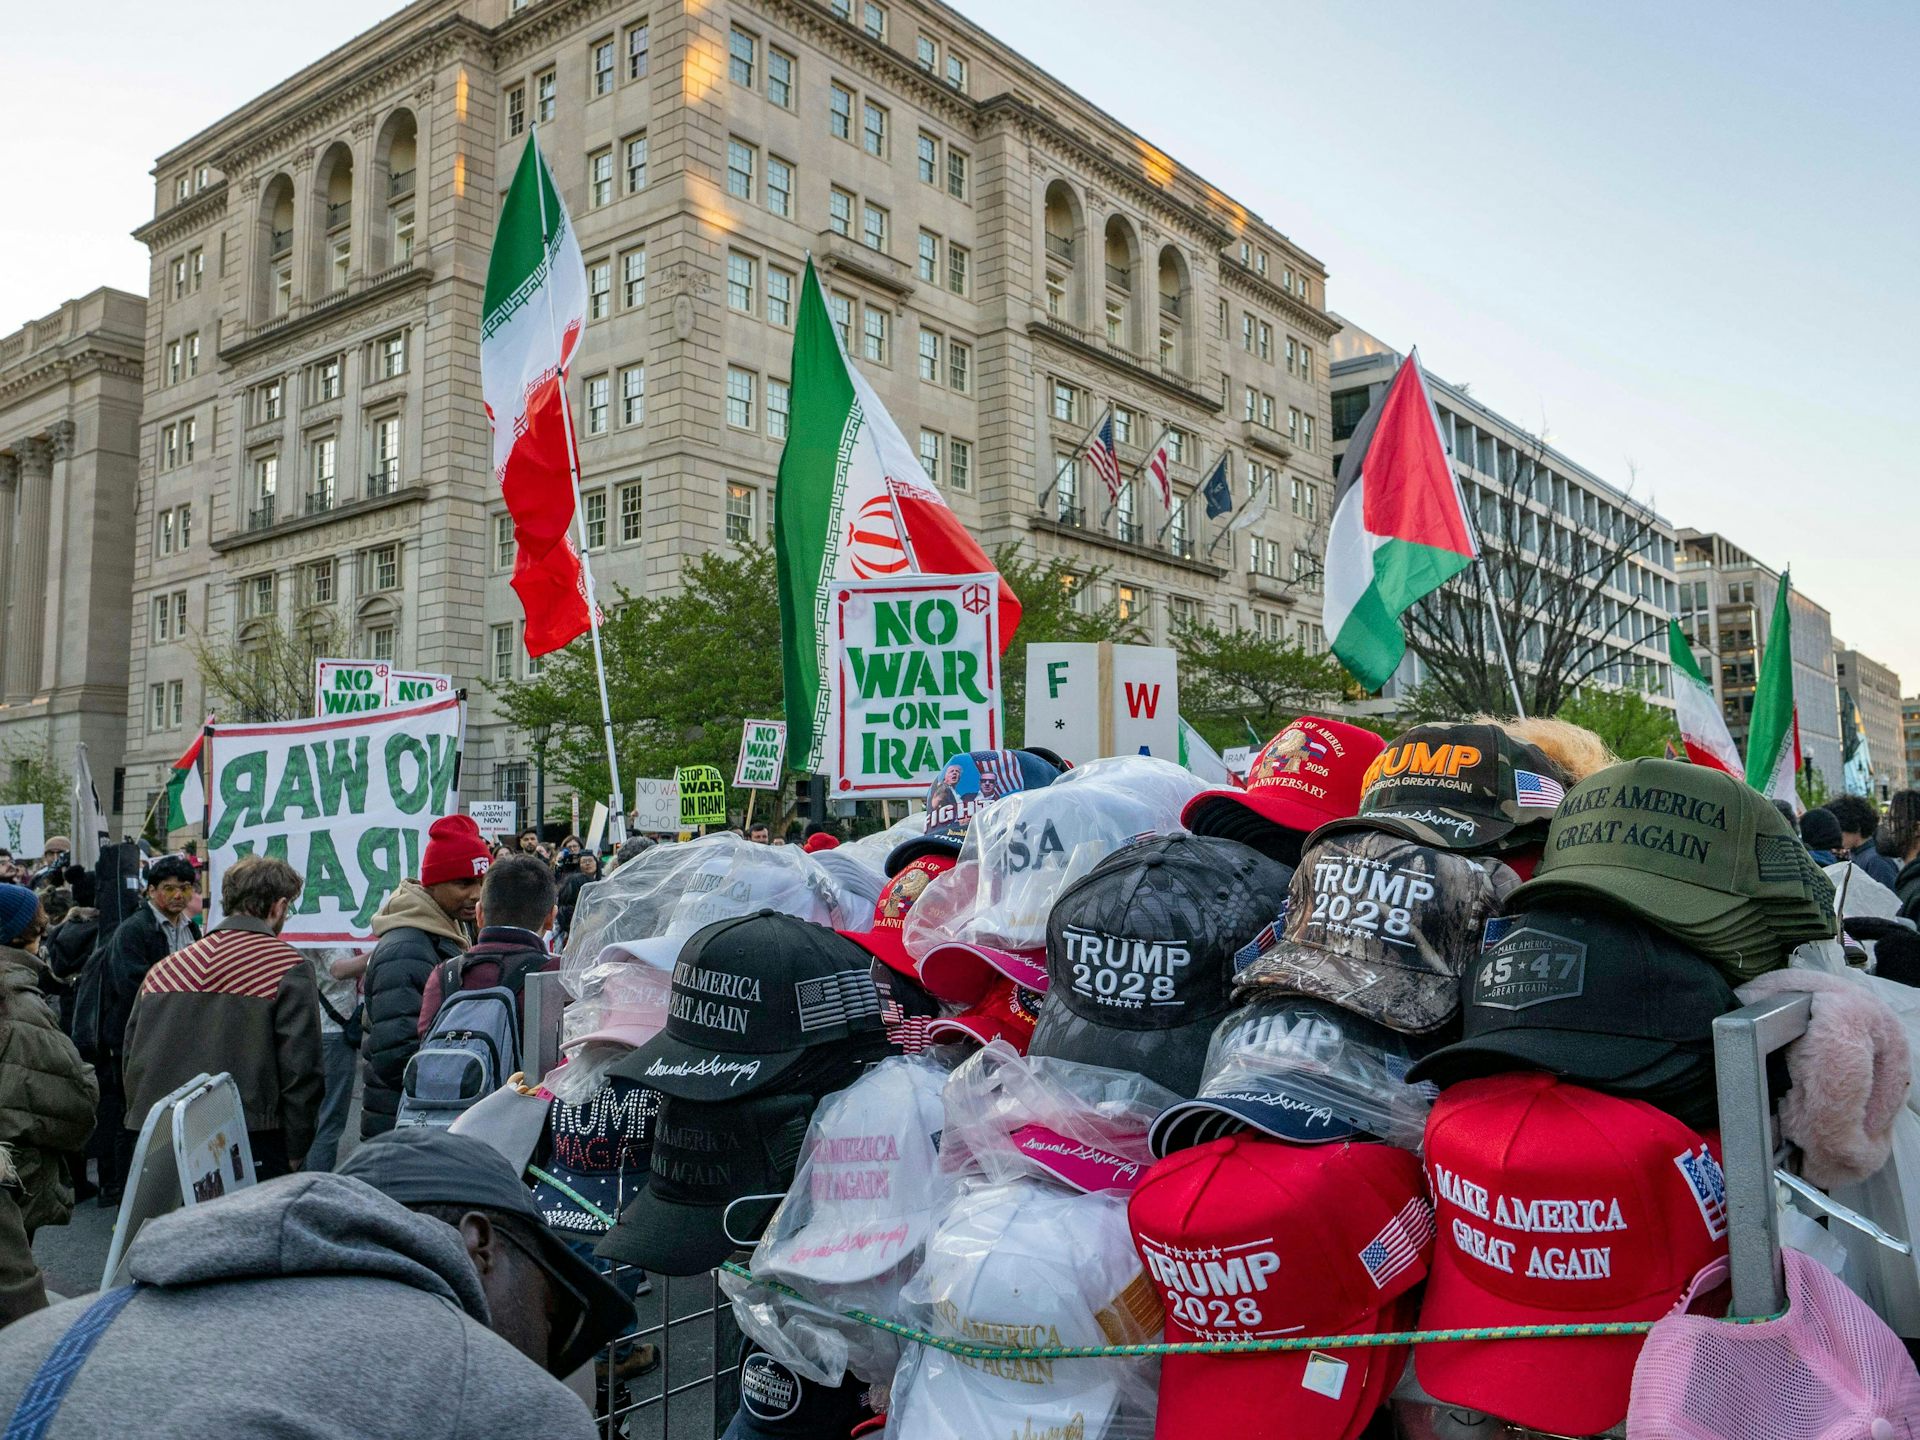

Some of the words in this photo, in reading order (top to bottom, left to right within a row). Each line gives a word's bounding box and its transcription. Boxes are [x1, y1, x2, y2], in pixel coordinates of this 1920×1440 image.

[873, 598, 959, 648] NO
[335, 668, 374, 692] NO
[397, 680, 434, 702] NO
[846, 647, 989, 705] WAR
[746, 739, 779, 761] WAR
[755, 726, 777, 742] NO
[1304, 721, 1319, 731] OF
[1316, 727, 1346, 759] AMERICA
[861, 728, 971, 780] IRAN
[1225, 752, 1247, 764] IRAN
[1304, 761, 1330, 778] 2026
[637, 781, 657, 795] NO
[660, 782, 679, 796] WA
[679, 768, 703, 781] STOP
[680, 780, 723, 794] WAR
[743, 766, 774, 782] IRAN
[1253, 776, 1328, 800] ANNIVERSARY
[1401, 776, 1438, 787] GREAT
[1437, 778, 1473, 794] AGAIN
[483, 816, 504, 824] NOW
[655, 798, 676, 812] OF
[681, 796, 696, 817] ON
[697, 794, 725, 816] IRAN!
[1557, 786, 1611, 821] MAKE
[1611, 784, 1728, 832] AMERICA
[1556, 820, 1623, 851] GREAT
[1621, 822, 1711, 865] AGAIN
[1313, 863, 1435, 909] TRUMP
[1311, 893, 1412, 936] 2028
[1062, 930, 1191, 976] TRUMP
[1497, 942, 1517, 954] MAKE
[1518, 940, 1553, 950] AMERICA
[687, 965, 762, 1003] AMERICA
[1072, 963, 1176, 1001] 2028
[1479, 955, 1514, 988] 45
[1529, 953, 1578, 980] 47
[1491, 984, 1517, 998] GREAT
[1519, 983, 1549, 993] AGAIN
[692, 1000, 750, 1035] AGAIN
[555, 1132, 638, 1171] MAGA
[1434, 1163, 1490, 1221] MAKE
[1493, 1194, 1628, 1234] AMERICA
[1452, 1217, 1516, 1274] GREAT
[1525, 1246, 1611, 1280] AGAIN
[1141, 1243, 1281, 1297] TRUMP
[1167, 1290, 1263, 1328] 2028
[961, 1317, 1063, 1350] AMERICA
